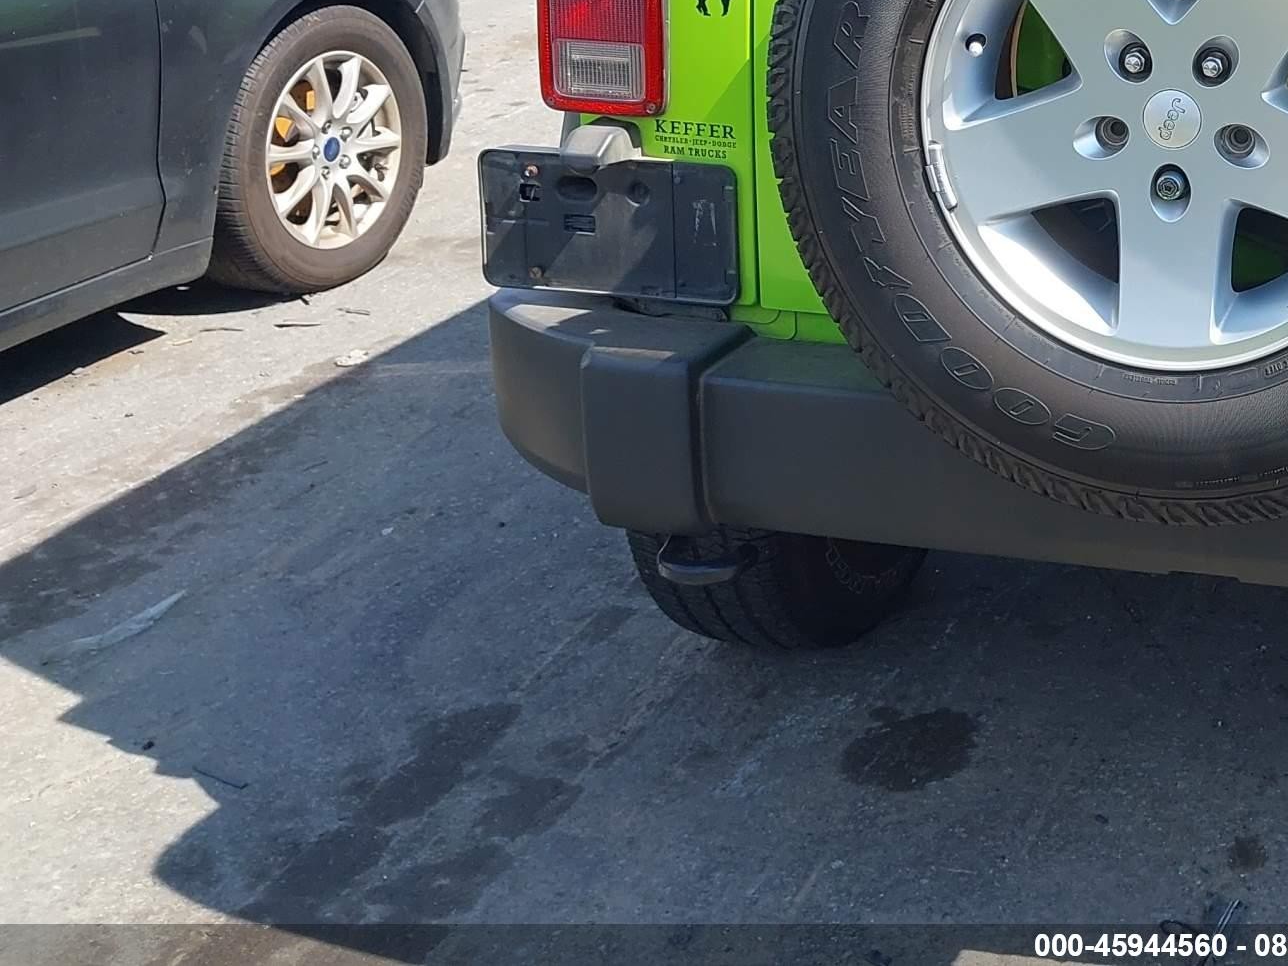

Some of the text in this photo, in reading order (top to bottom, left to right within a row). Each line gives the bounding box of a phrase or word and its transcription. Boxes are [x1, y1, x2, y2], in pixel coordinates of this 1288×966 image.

[654, 118, 737, 140] KEFFER
[1158, 97, 1186, 141] Jeep
[663, 144, 727, 159] RAM TRUCKS
[827, 0, 1116, 451] GOODYEAR
